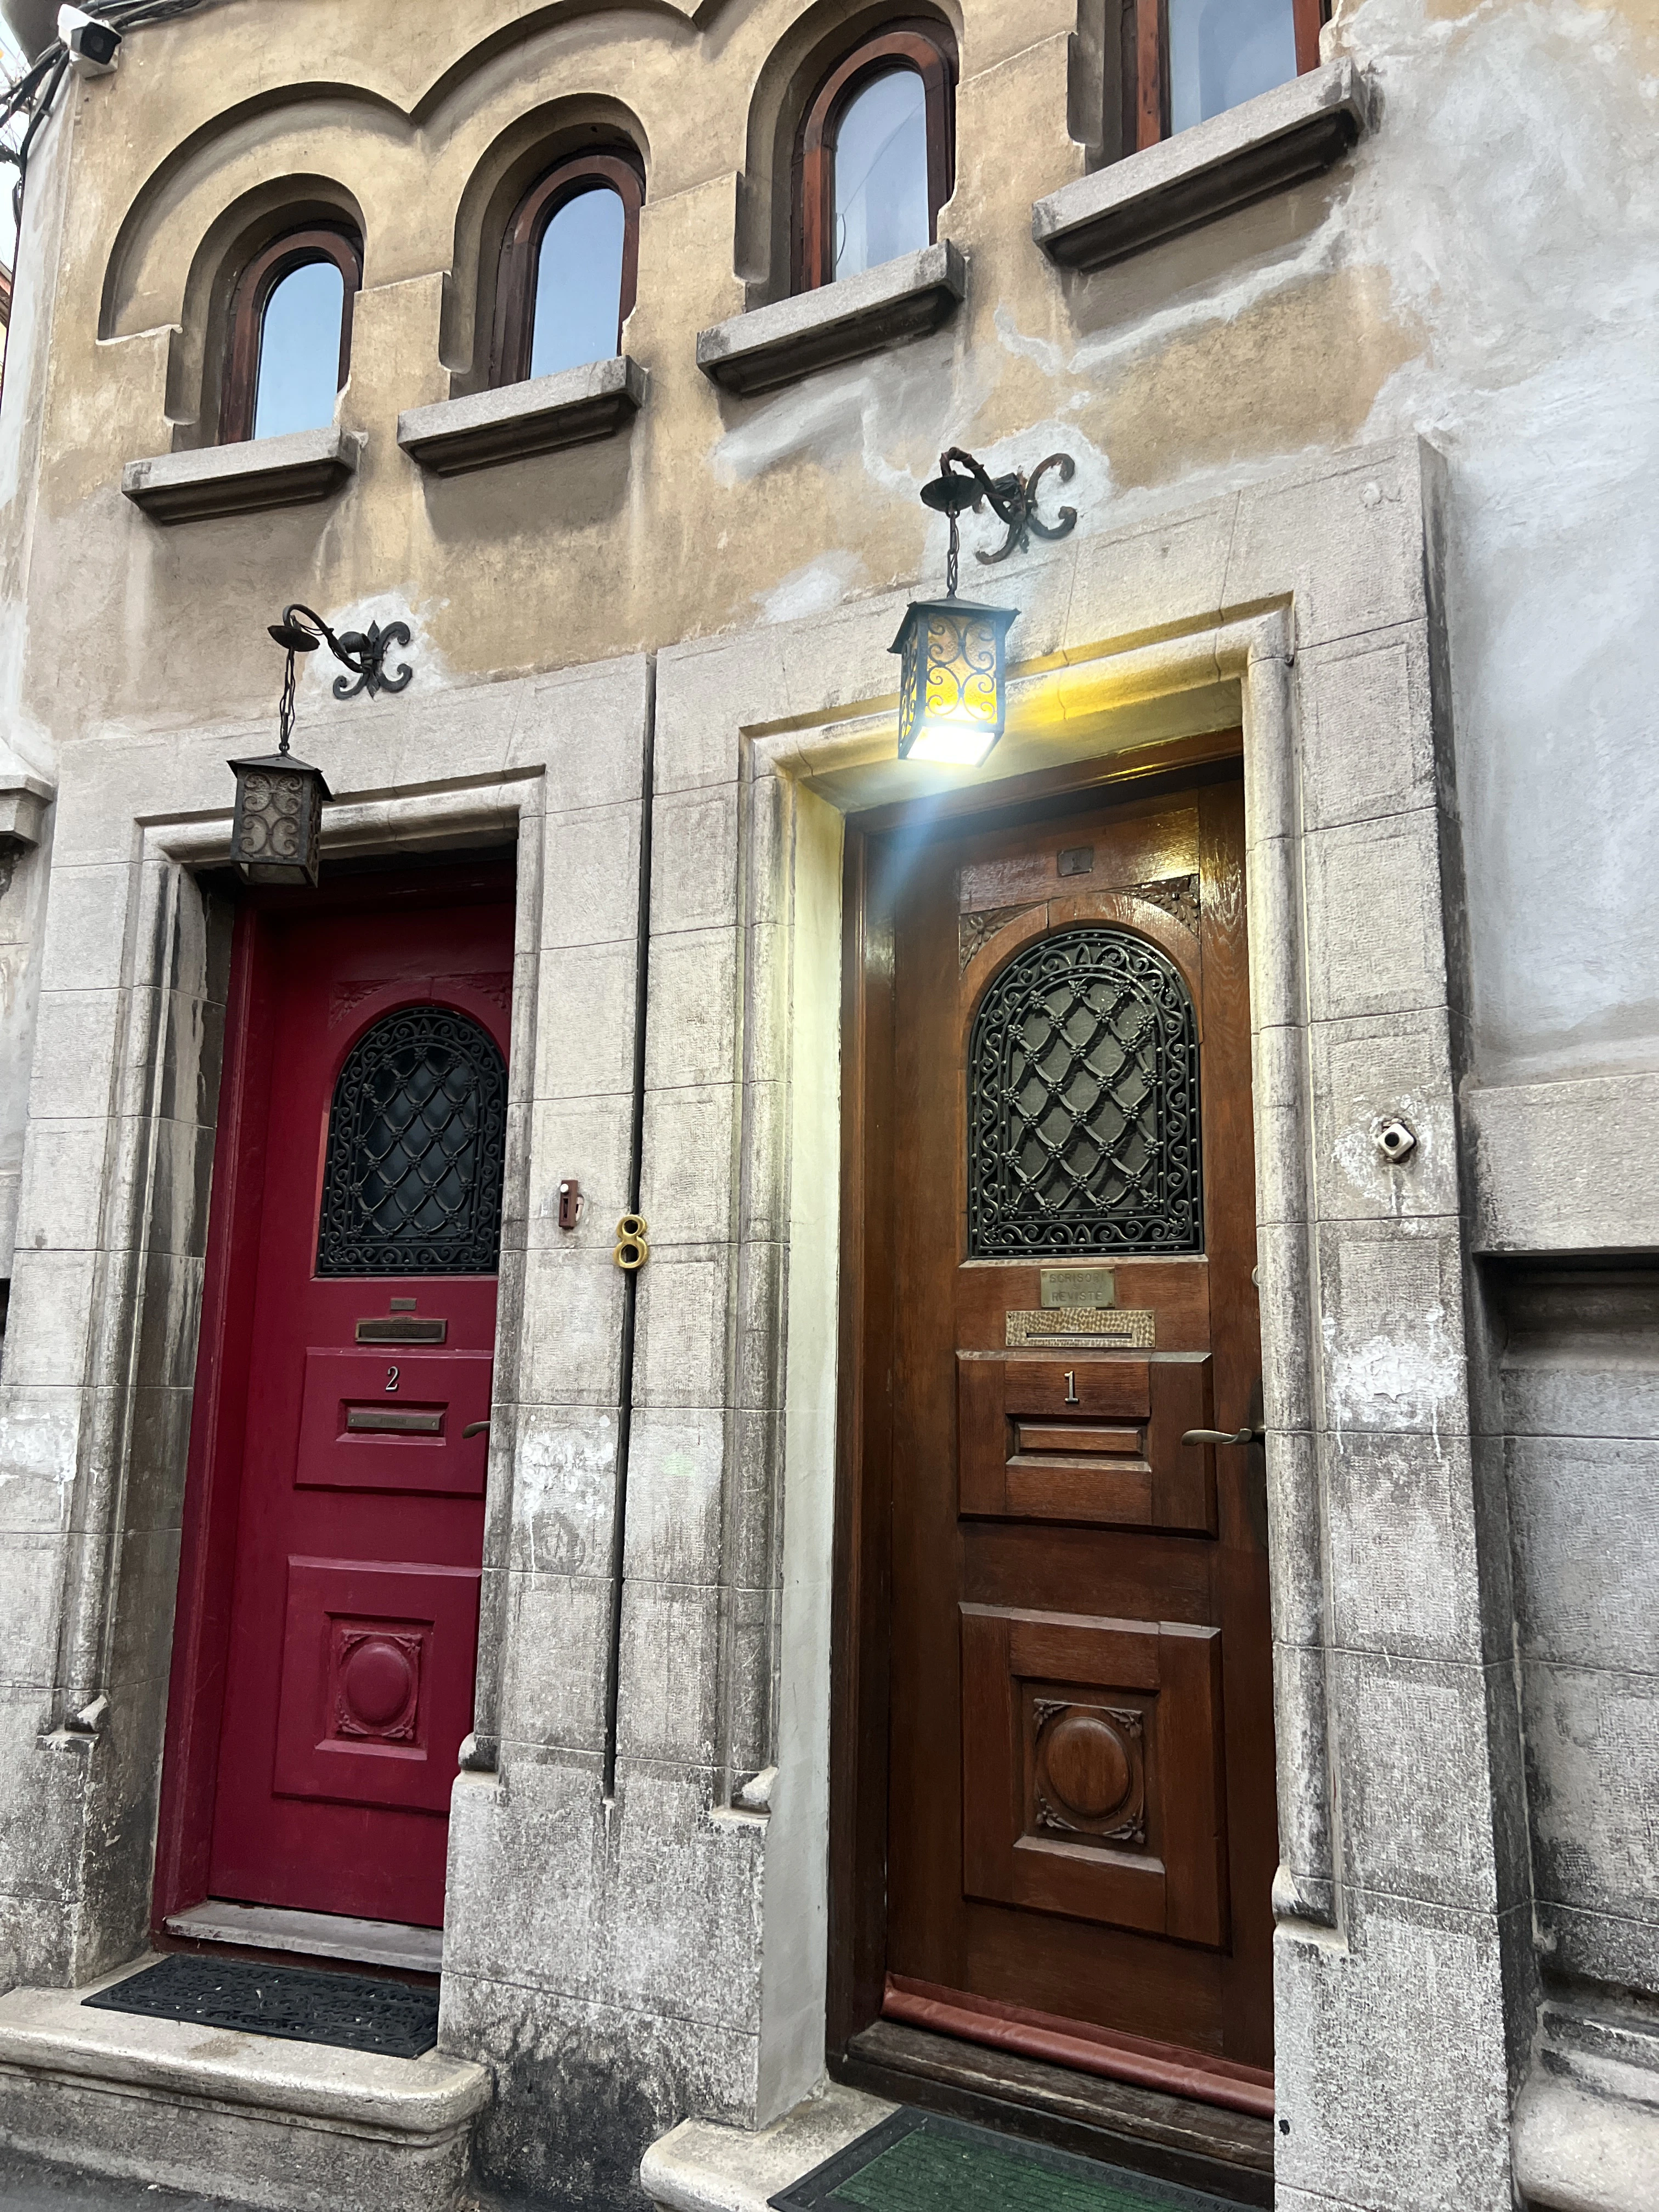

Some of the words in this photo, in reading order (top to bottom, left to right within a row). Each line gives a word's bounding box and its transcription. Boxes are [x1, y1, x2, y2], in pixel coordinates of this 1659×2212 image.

[612, 1214, 650, 1269] 8
[1049, 1273, 1104, 1283] SCRISORI
[1051, 1291, 1103, 1302] REVISTE
[385, 1366, 398, 1390] 2
[1064, 1370, 1079, 1402] 1
